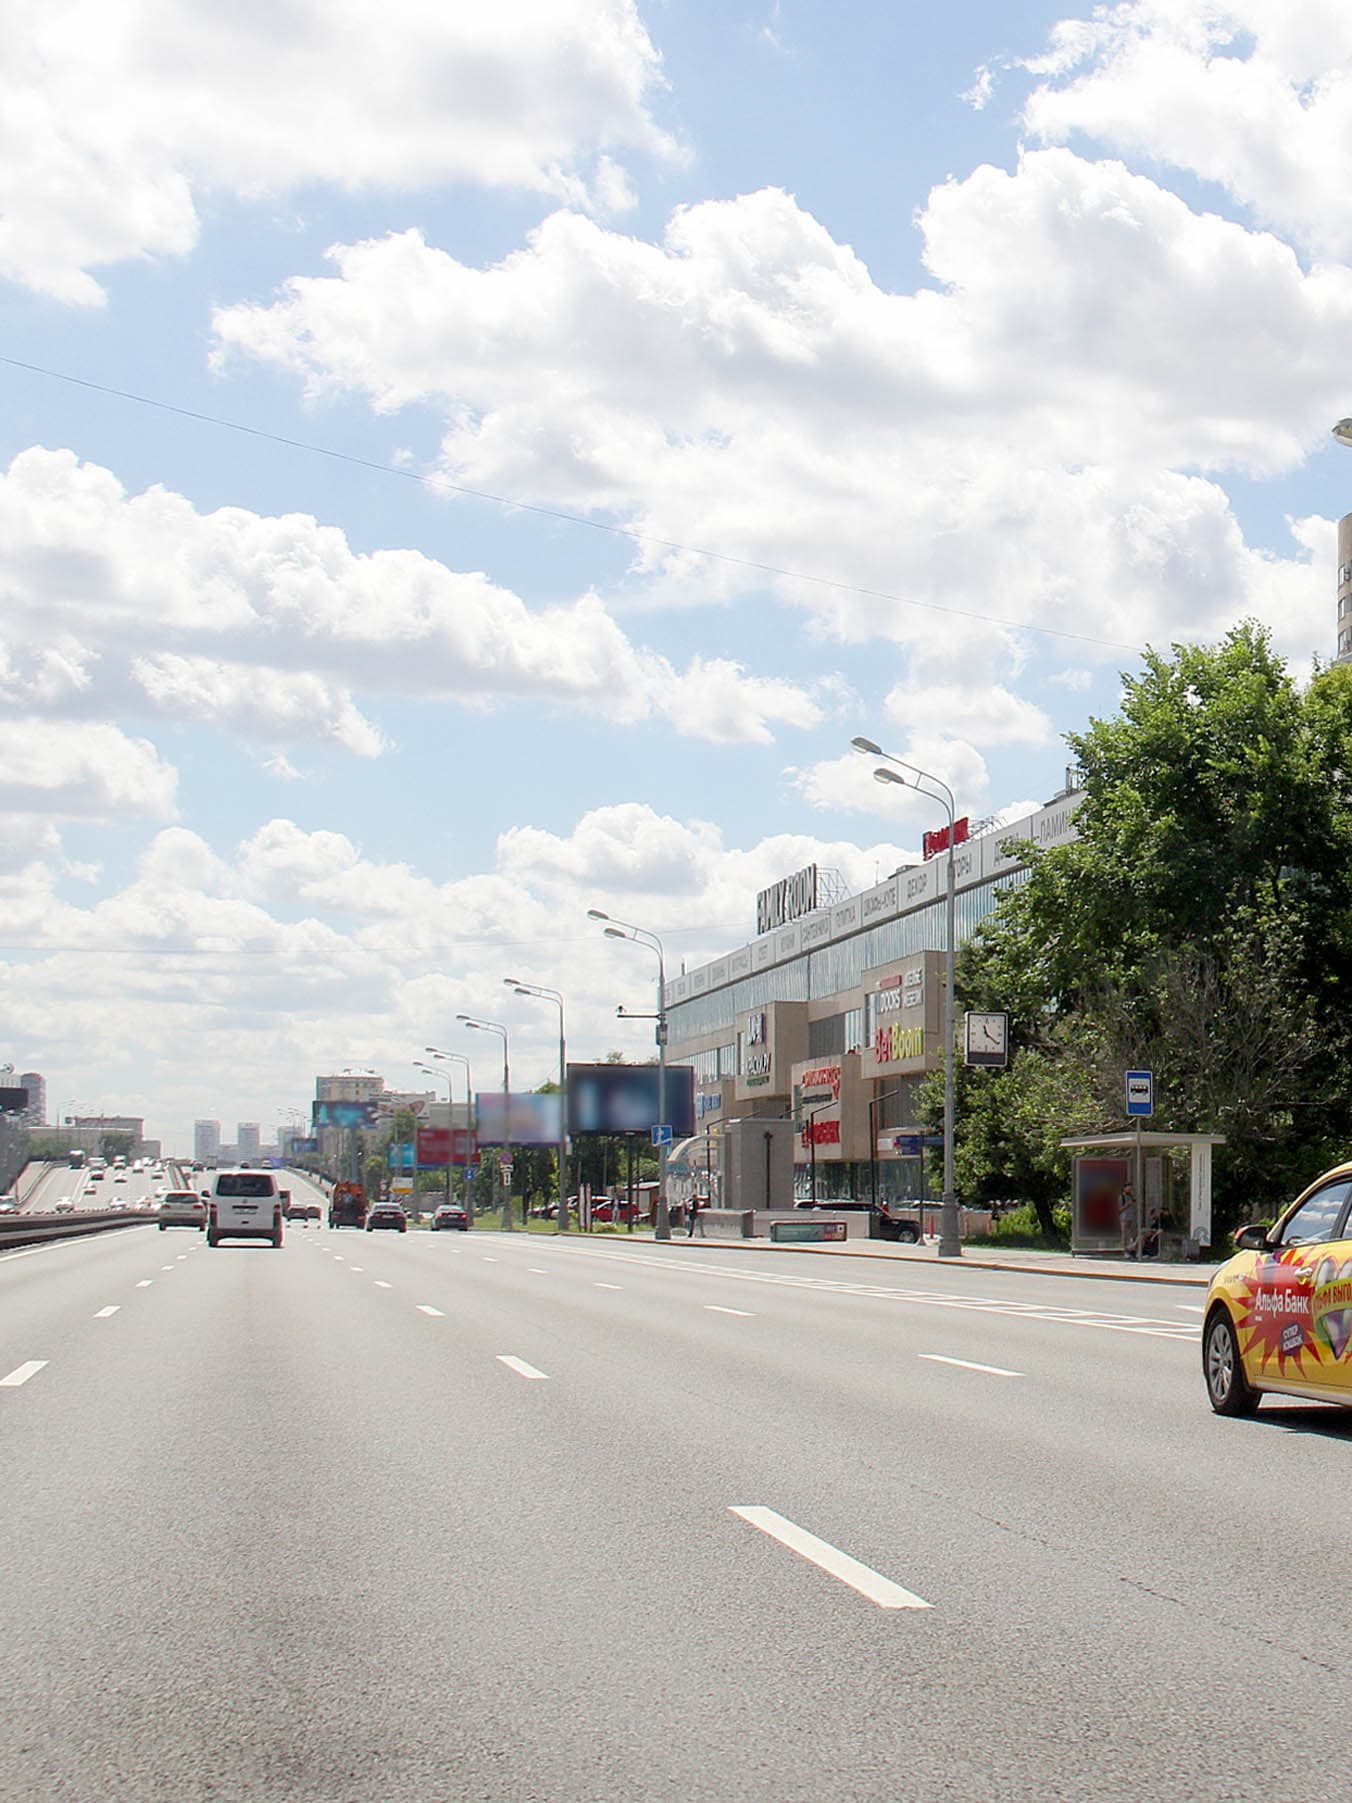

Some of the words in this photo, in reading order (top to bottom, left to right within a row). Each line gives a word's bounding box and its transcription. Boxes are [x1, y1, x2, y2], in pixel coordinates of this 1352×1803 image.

[757, 878, 786, 934] FAMILY
[787, 862, 817, 919] ROOM
[875, 1022, 924, 1064] BetBoom
[1255, 1288, 1283, 1318] Альфа
[1285, 1288, 1309, 1314] Банк
